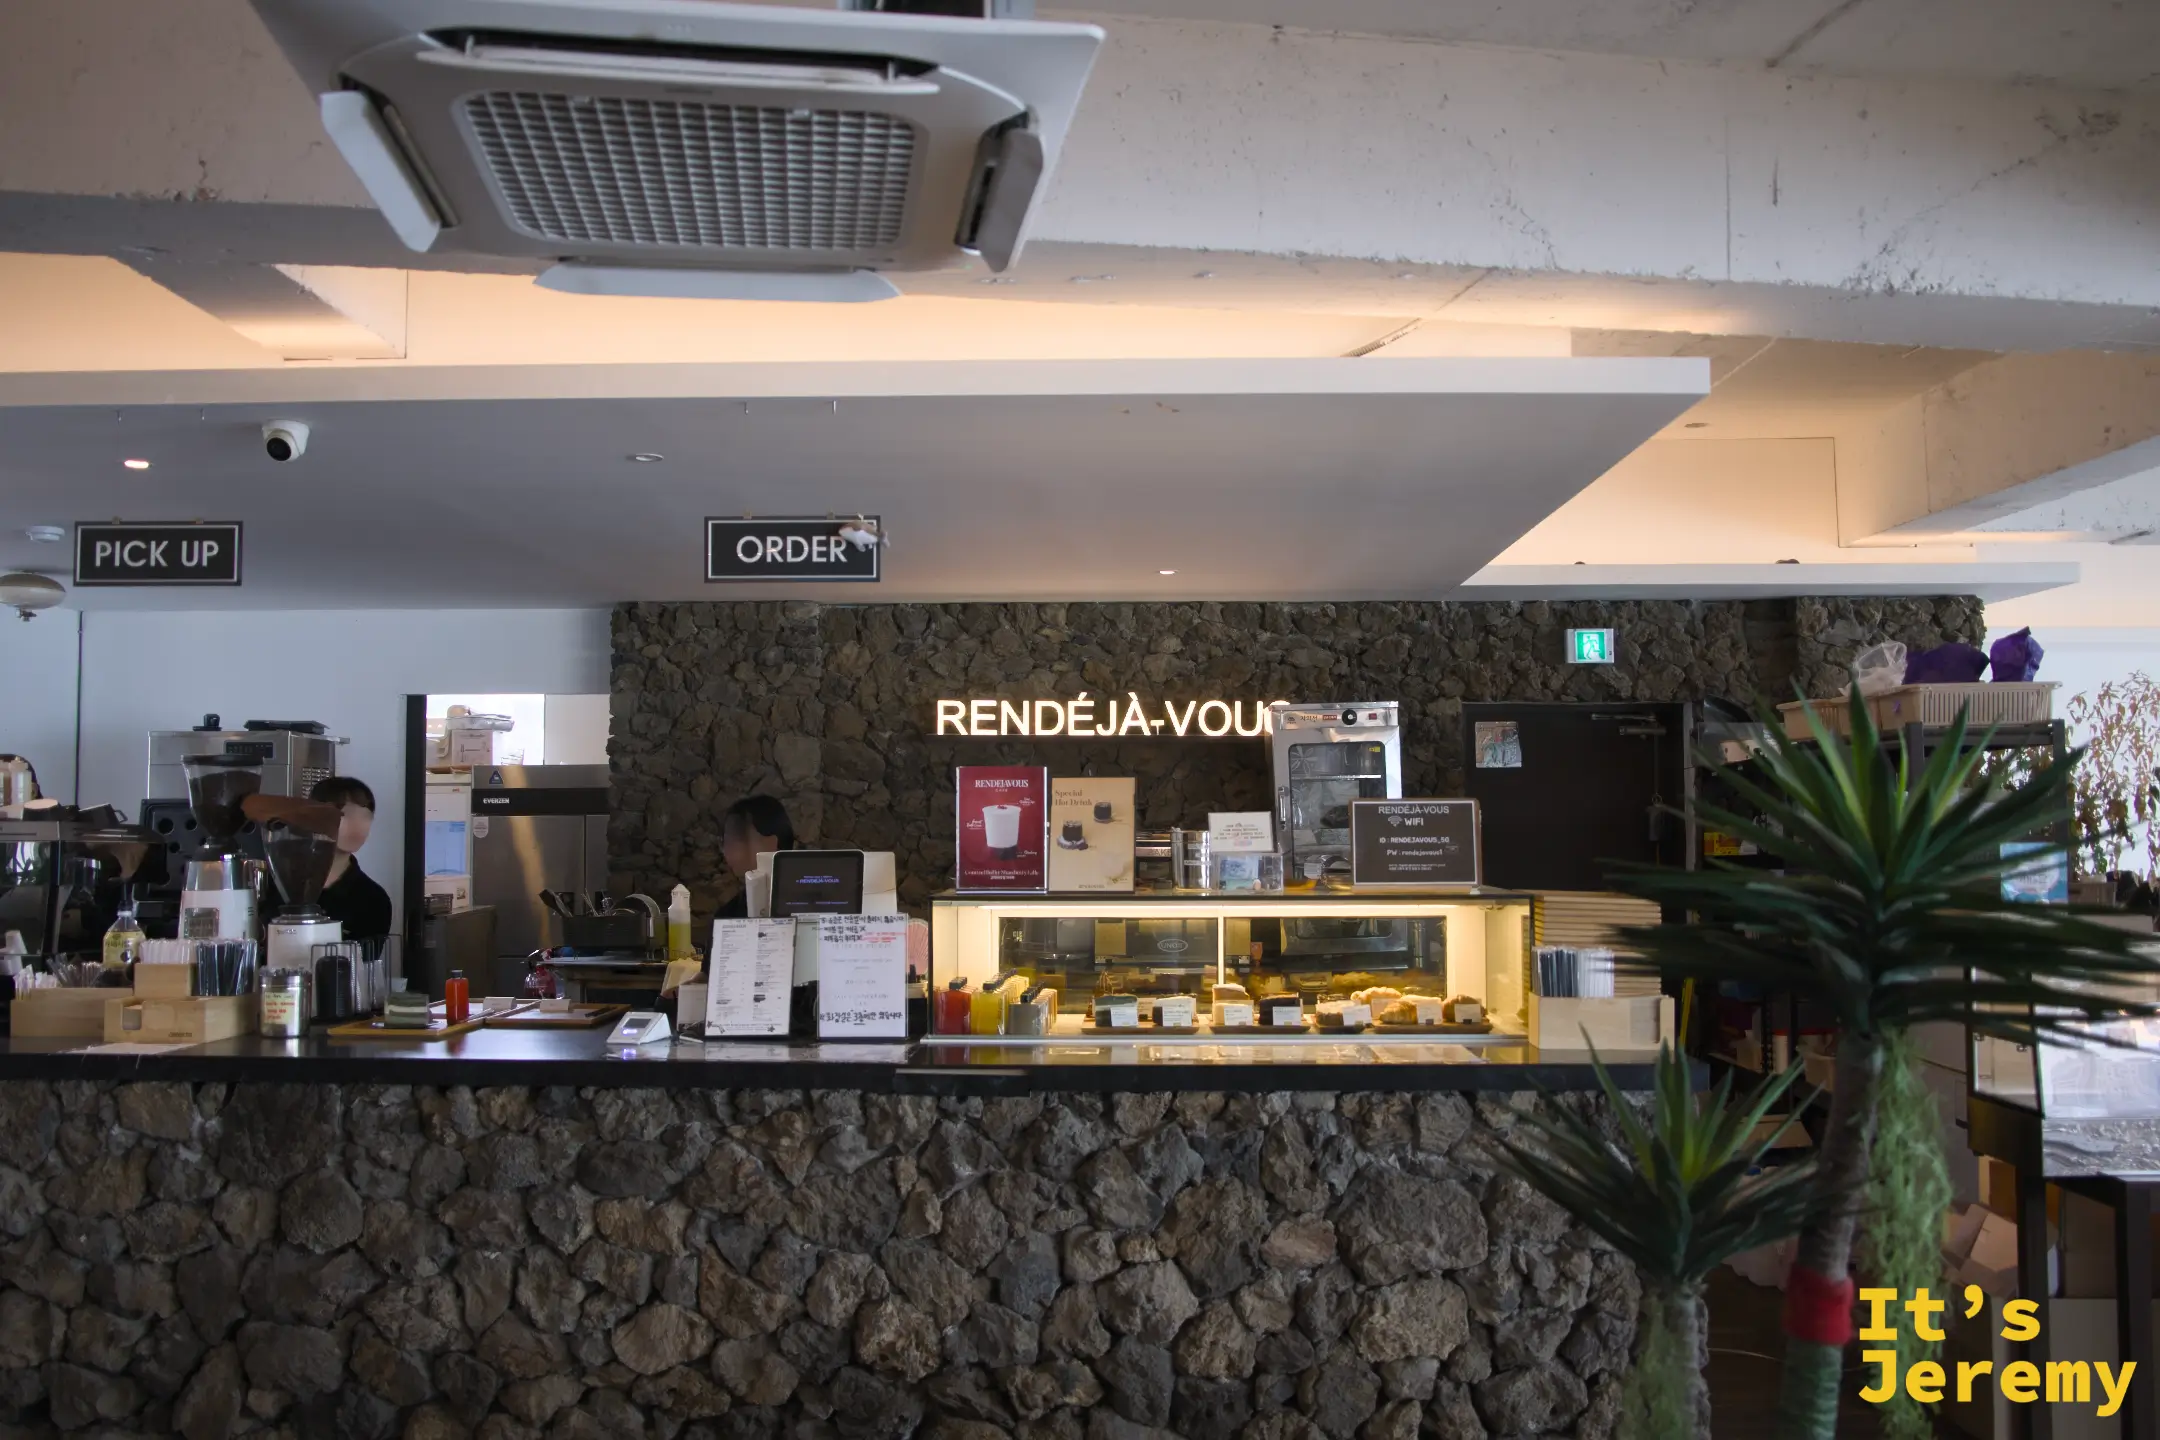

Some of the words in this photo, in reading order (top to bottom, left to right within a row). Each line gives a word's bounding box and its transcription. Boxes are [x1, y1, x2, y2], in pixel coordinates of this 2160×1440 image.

[95, 540, 169, 567] PICK
[181, 540, 219, 567] UP
[736, 535, 848, 563] ORDER
[1055, 789, 1083, 798] Special
[1404, 817, 1424, 826] WIFI
